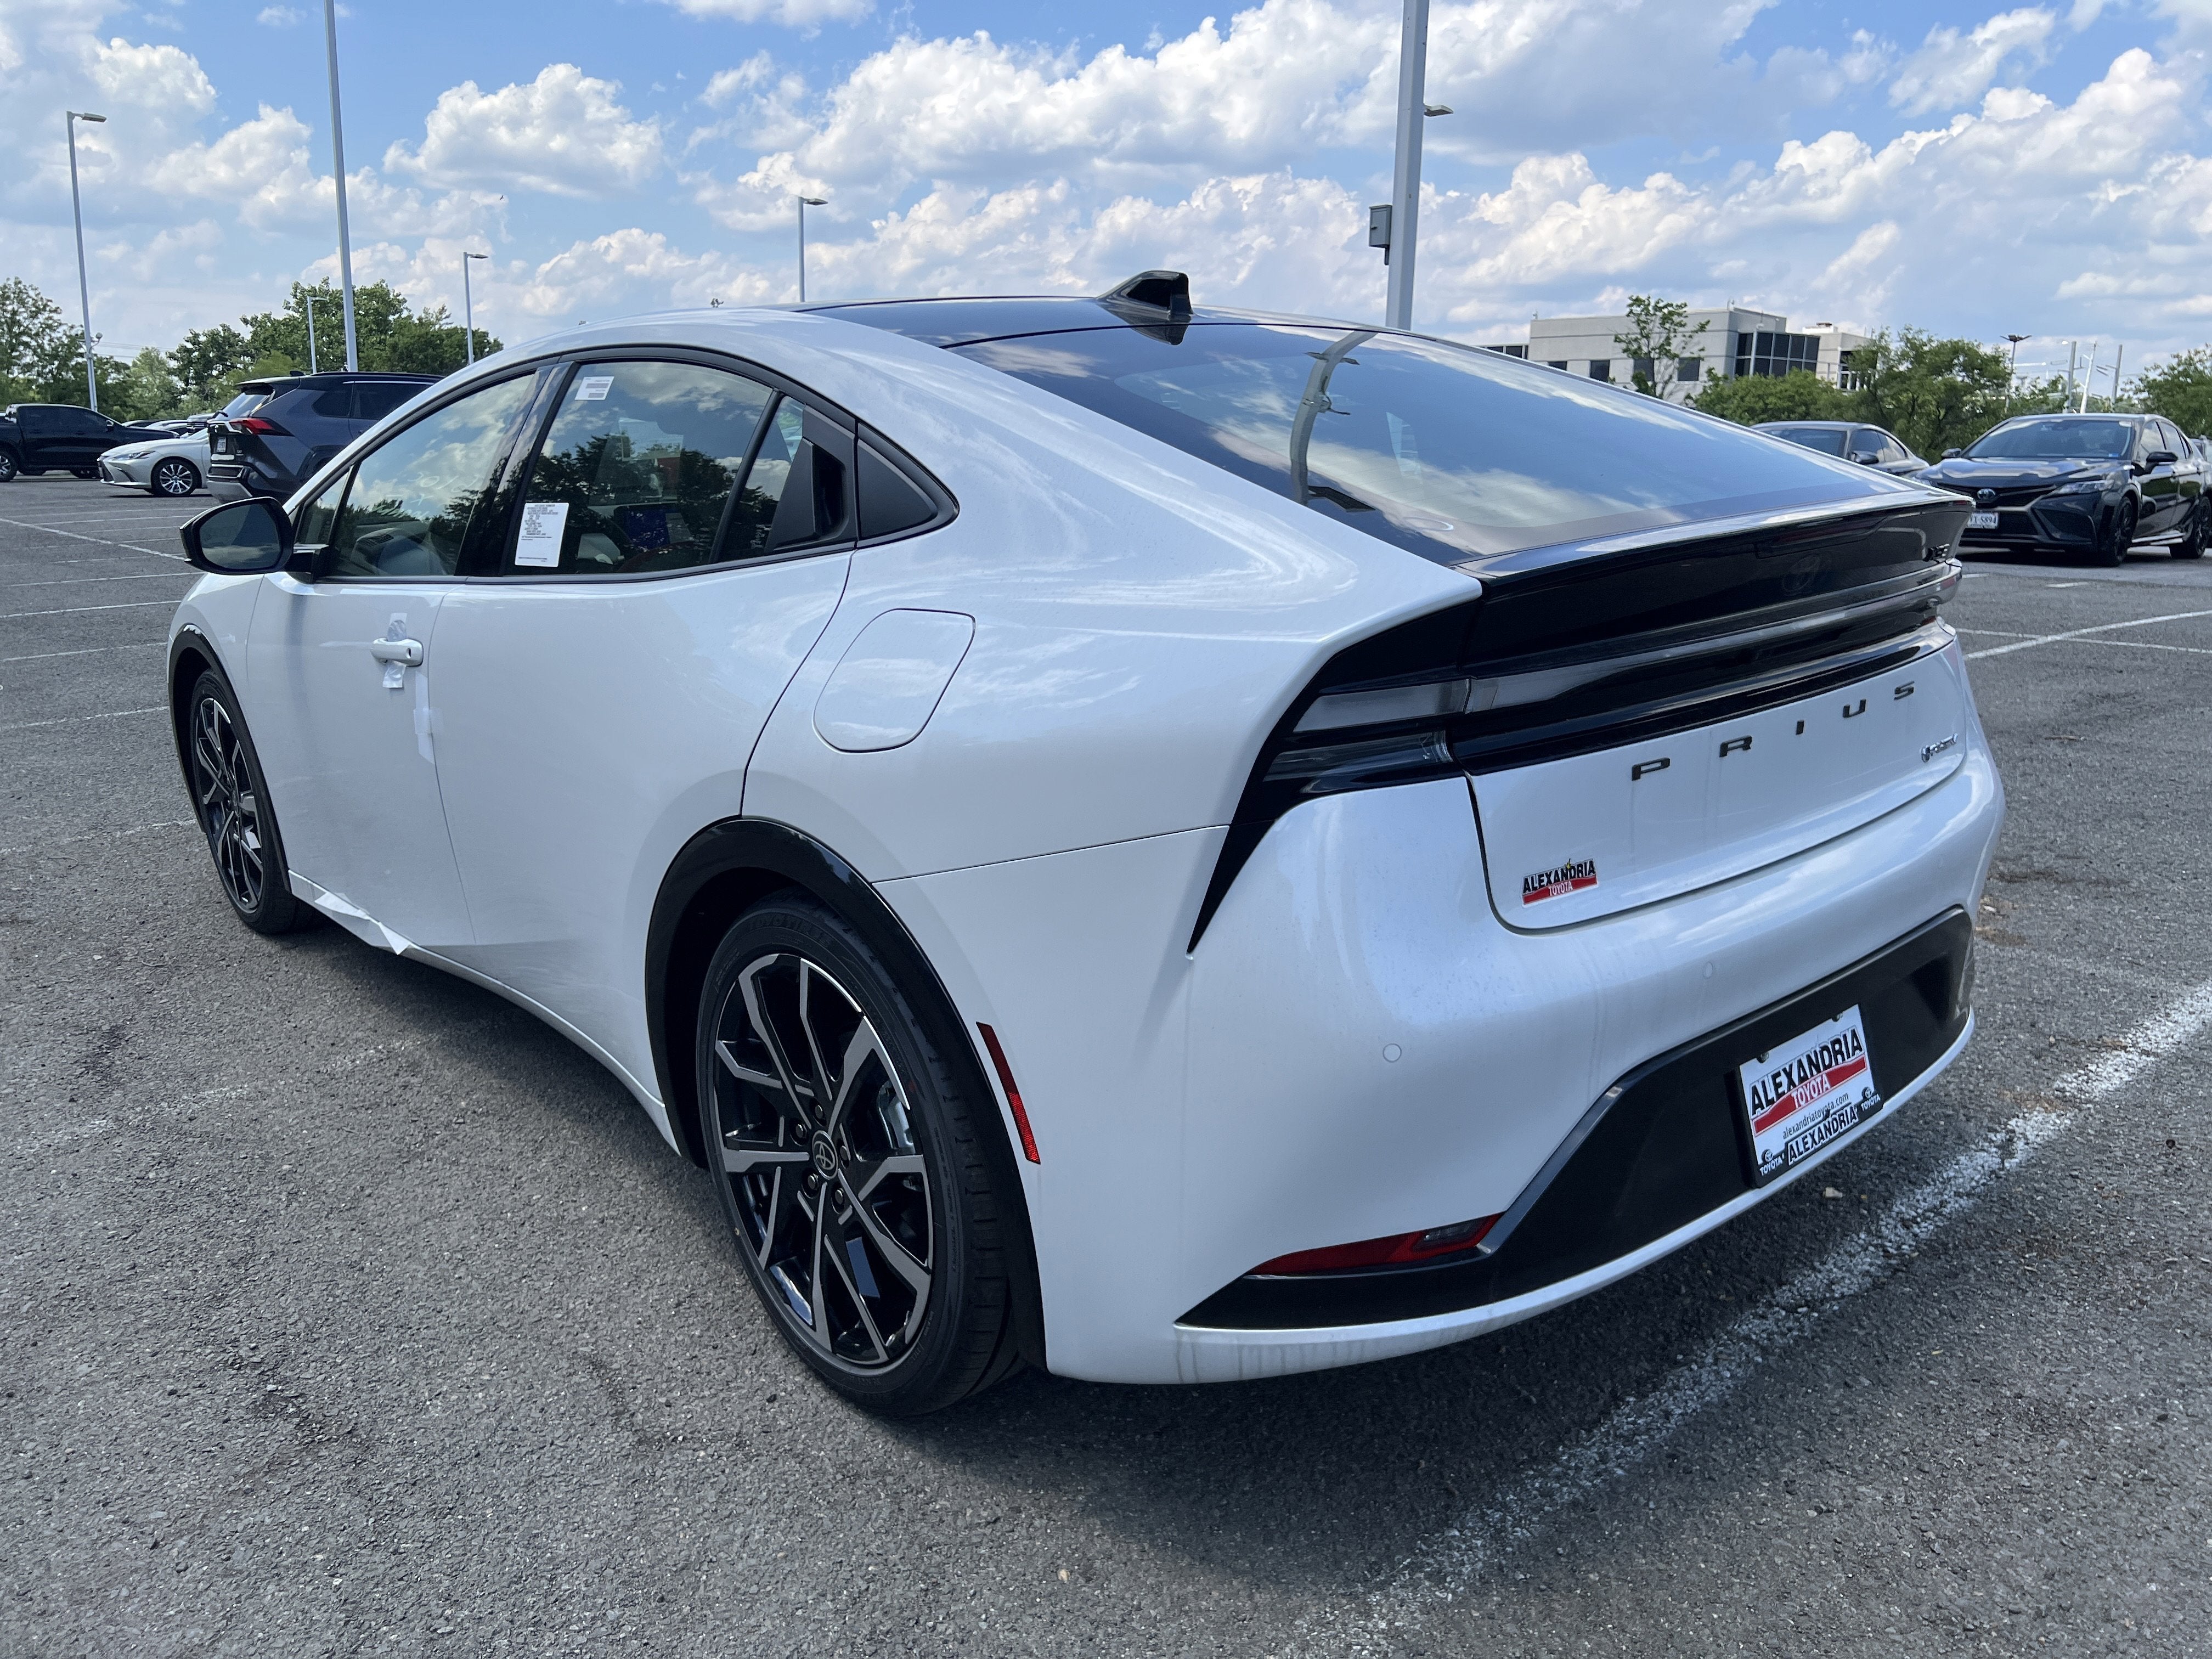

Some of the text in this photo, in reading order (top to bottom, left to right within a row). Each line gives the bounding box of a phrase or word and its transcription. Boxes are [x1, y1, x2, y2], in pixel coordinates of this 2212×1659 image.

[1632, 681, 1915, 781] PRIUS
[1522, 860, 1596, 894] ALEXANDRIA
[1549, 881, 1573, 896] TOYOTA
[1751, 1028, 1863, 1116] ALEXANDRIA
[1791, 1074, 1831, 1109] TOYOTA
[1861, 1093, 1881, 1111] TOYOTA
[1783, 1093, 1849, 1139] alexandriatoyota.com
[1788, 1105, 1858, 1164] ALEXANDRIA
[1759, 1157, 1783, 1176] TOYOTA
